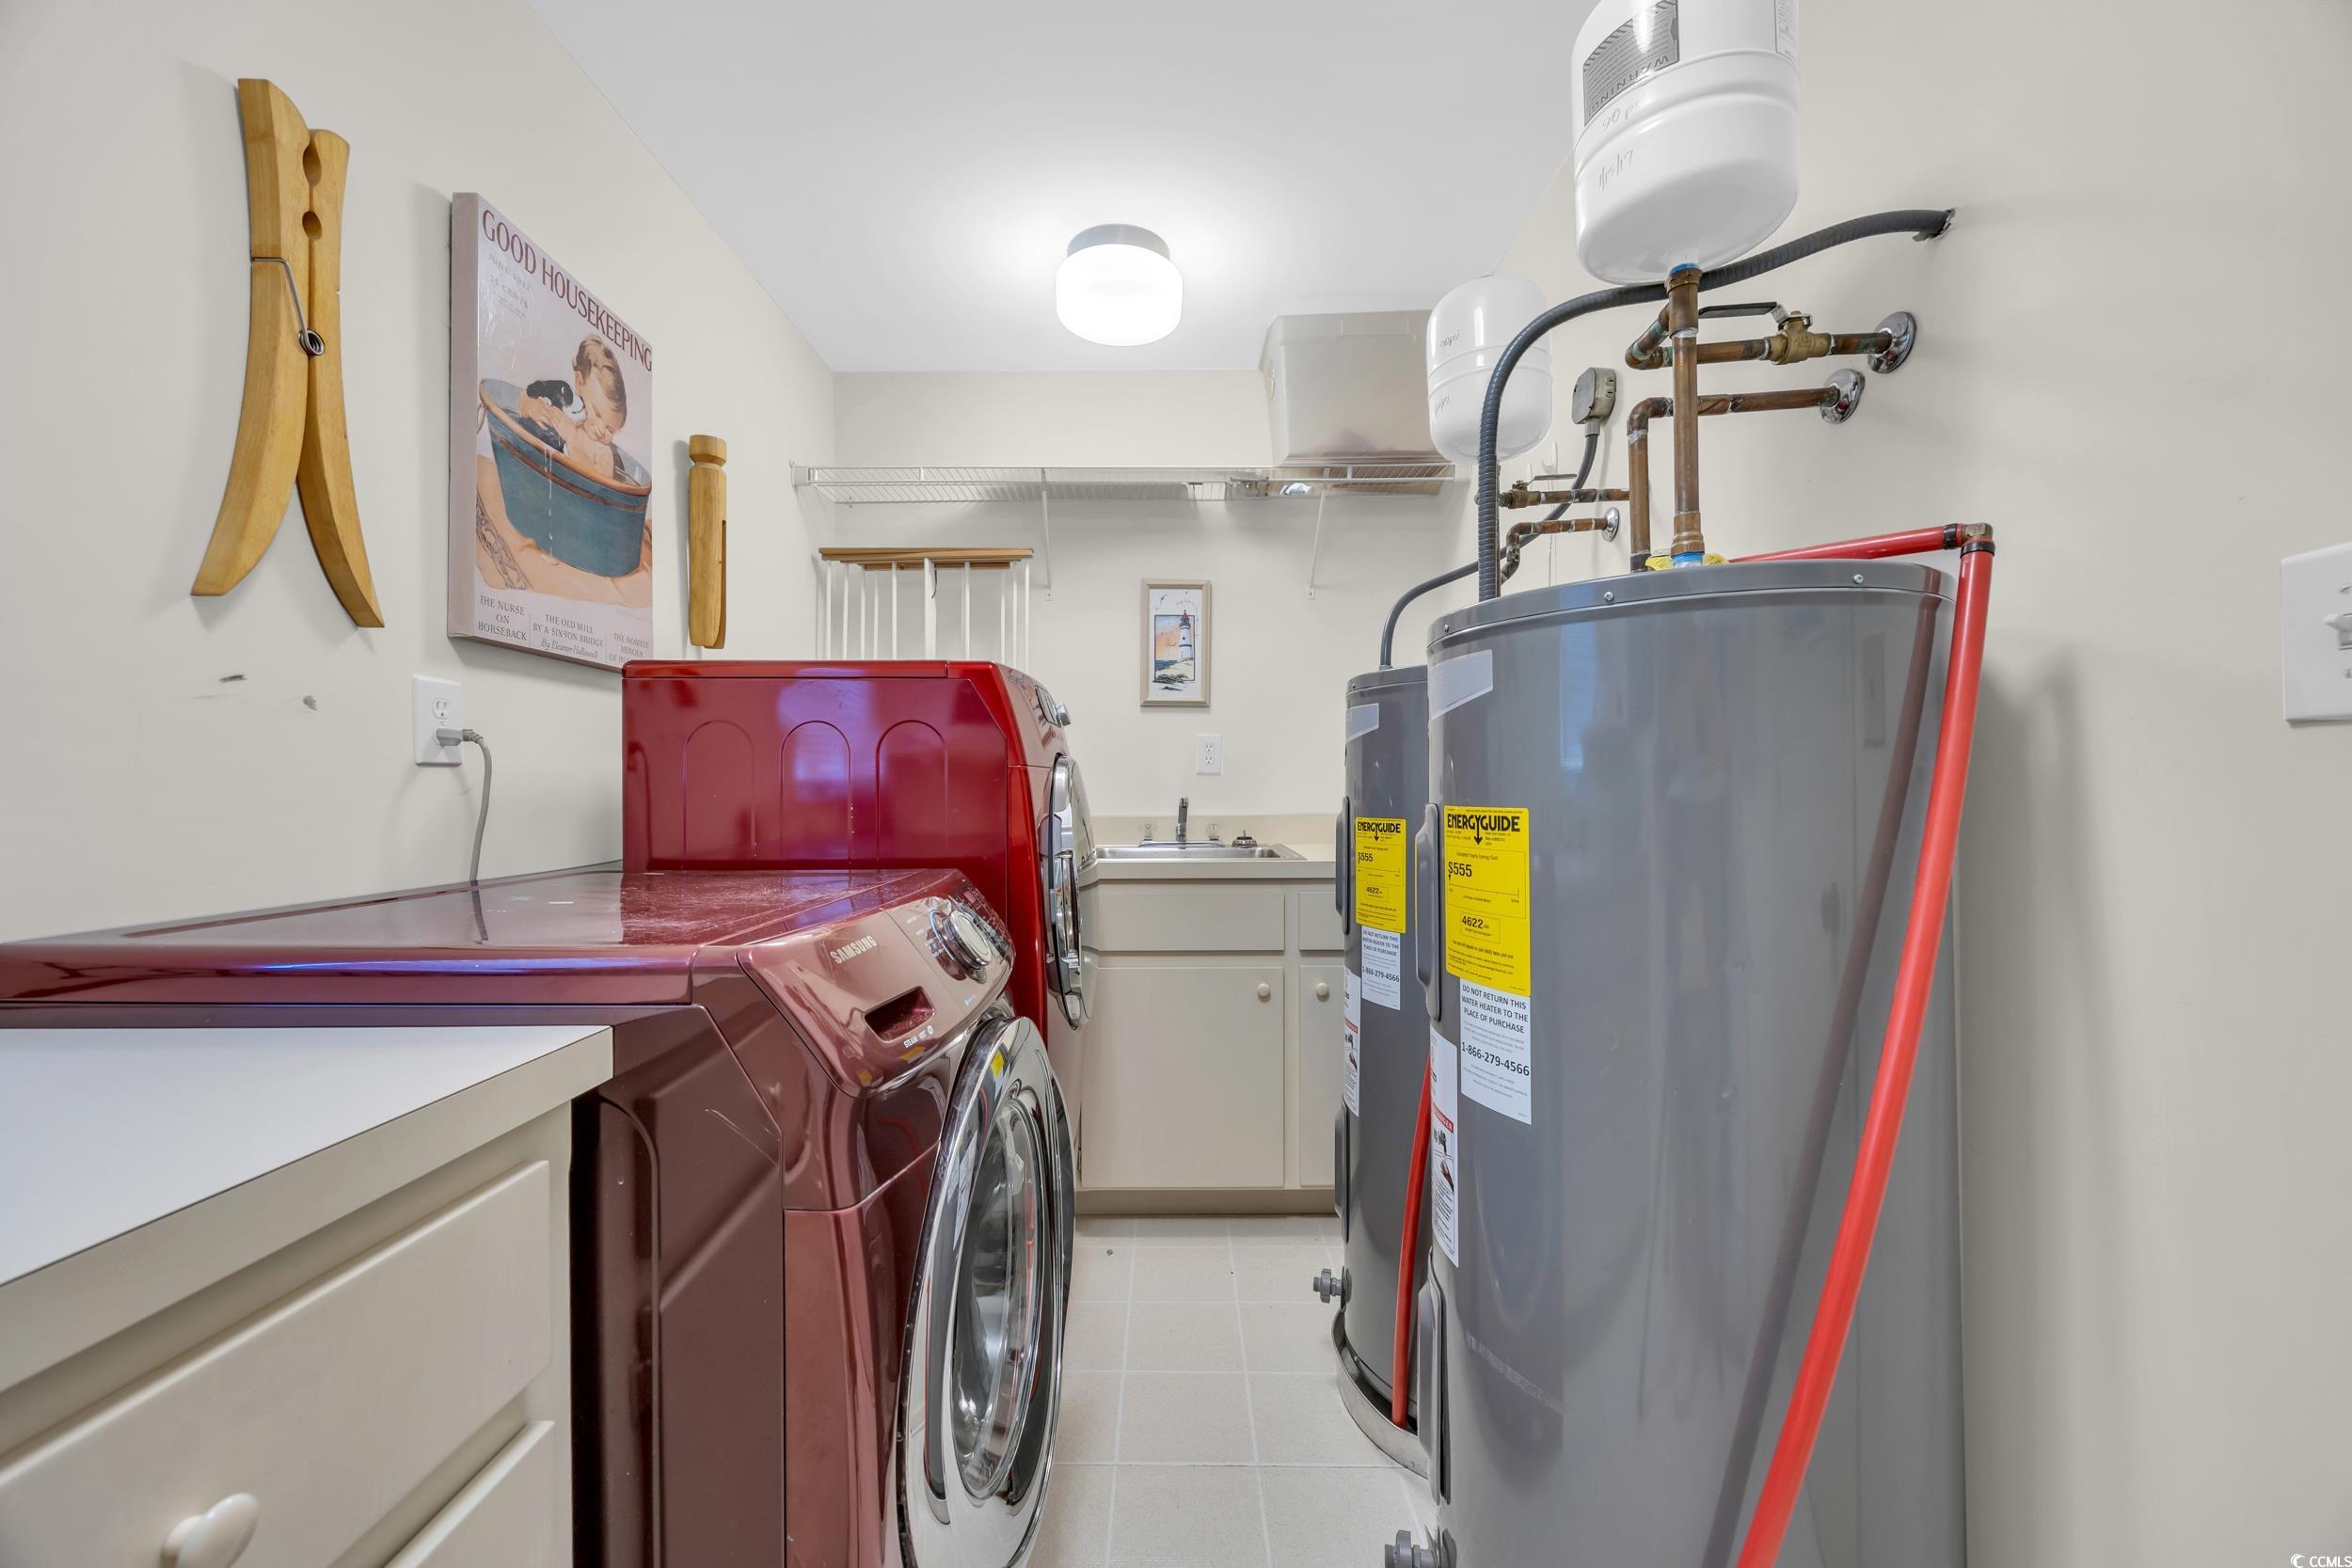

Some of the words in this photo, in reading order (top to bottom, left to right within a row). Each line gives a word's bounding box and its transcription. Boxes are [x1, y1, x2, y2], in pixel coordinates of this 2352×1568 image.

[482, 209, 537, 275] GOOD
[542, 258, 652, 372] HOUSEKEEPING
[480, 594, 496, 609] THE
[498, 600, 526, 616] NURSE
[496, 613, 510, 625] ON
[546, 614, 560, 626] THE
[561, 619, 576, 629] OLD
[577, 622, 594, 635] MILL
[478, 620, 527, 641] HORSEBACK
[532, 622, 542, 633] BY
[544, 626, 549, 635] A
[579, 634, 605, 648] BRIDGE
[613, 632, 626, 643] THE
[1357, 821, 1401, 834] ENERGYGUIDE
[1447, 813, 1521, 833] ENERGYGUIDE
[1447, 861, 1473, 879] $555
[1461, 915, 1485, 930] 4622
[830, 935, 878, 964] SAMSUNG
[1462, 984, 1470, 993] DO
[1470, 988, 1482, 997] NOT
[1483, 991, 1509, 1006] RETURN
[1510, 999, 1527, 1010] THIS
[1462, 994, 1478, 1007] WATER
[1479, 1002, 1502, 1016] HEATER
[1503, 1008, 1513, 1018] TO
[1514, 1012, 1529, 1022] THE
[1464, 1006, 1480, 1020] PLACE
[1480, 1013, 1488, 1022] OF
[1488, 1017, 1525, 1034] PURCHASE
[1461, 1041, 1530, 1076] 1-866-279-4566
